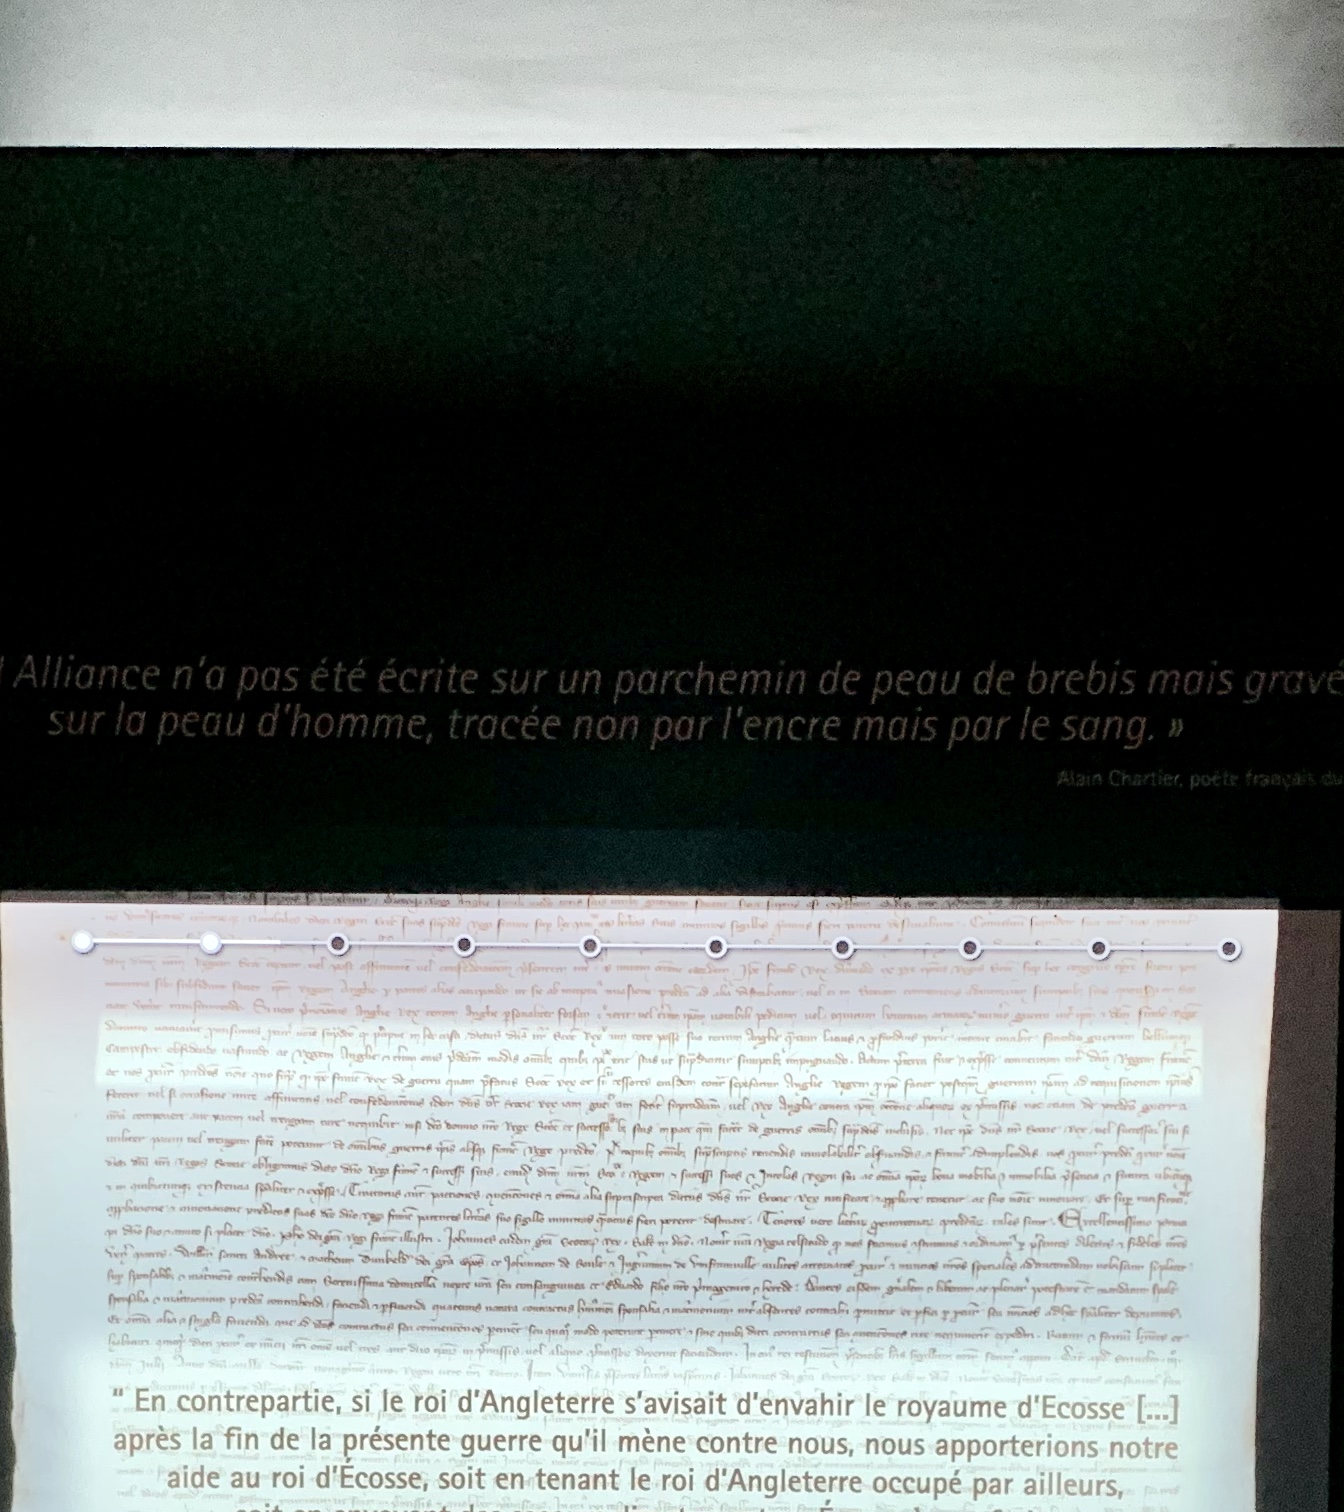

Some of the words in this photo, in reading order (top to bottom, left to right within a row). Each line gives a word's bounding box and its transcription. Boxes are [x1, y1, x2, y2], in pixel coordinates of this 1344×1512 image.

[14, 655, 160, 690] Alliance
[237, 667, 298, 699] pas
[310, 659, 365, 693] été
[379, 659, 478, 694] écrite
[492, 669, 547, 694] sur
[559, 670, 601, 694] un
[613, 661, 807, 703] parchemin
[819, 661, 860, 695] de
[871, 670, 960, 703] peau
[974, 663, 1014, 694] de
[1028, 661, 1134, 694] brebis
[1148, 661, 1233, 695] mais
[49, 712, 104, 735] sur
[117, 702, 146, 735] la
[158, 712, 244, 744] peau
[450, 706, 561, 740] tracée
[573, 715, 638, 740] non
[650, 716, 712, 748] par
[853, 707, 937, 741] mais
[948, 716, 1010, 749] par
[1021, 707, 1049, 740] le
[1062, 716, 1153, 749] sang.
[1056, 769, 1102, 786] Alain
[1108, 769, 1182, 787] Chartier,
[1190, 769, 1239, 790] poète
[136, 1389, 166, 1411] En
[177, 1390, 342, 1417] contrepartie,
[352, 1390, 371, 1412] si
[384, 1390, 403, 1412] le
[414, 1390, 447, 1413] roi
[458, 1390, 614, 1419] d'Angleterre
[625, 1392, 726, 1414] s'avisait
[738, 1393, 853, 1415] d'envahir
[867, 1394, 885, 1416] le
[898, 1400, 1007, 1423] royaume
[1017, 1395, 1125, 1419] d'Ecosse
[113, 1428, 182, 1459] après
[193, 1429, 212, 1449] la
[225, 1428, 258, 1448] fin
[271, 1428, 299, 1449] de
[311, 1428, 331, 1449] la
[344, 1427, 449, 1456] présente
[462, 1435, 541, 1457] guerre
[552, 1428, 607, 1457] qu'il
[620, 1429, 685, 1452] mène
[697, 1434, 777, 1453] contre
[789, 1438, 853, 1455] nous,
[867, 1439, 924, 1454] nous
[935, 1438, 1099, 1464] apporterions
[1110, 1440, 1179, 1460] notre
[167, 1466, 220, 1488] aide
[232, 1473, 259, 1487] au
[272, 1467, 305, 1488] roi
[316, 1460, 429, 1492] d'Écosse,
[439, 1469, 484, 1489] soit
[496, 1474, 524, 1489] en
[537, 1470, 618, 1490] tenant
[632, 1468, 650, 1490] le
[662, 1469, 694, 1490] roi
[706, 1469, 862, 1498] d'Angleterre
[873, 1471, 961, 1499] occupé
[974, 1479, 1013, 1499] par
[1023, 1478, 1124, 1500] ailleurs,
